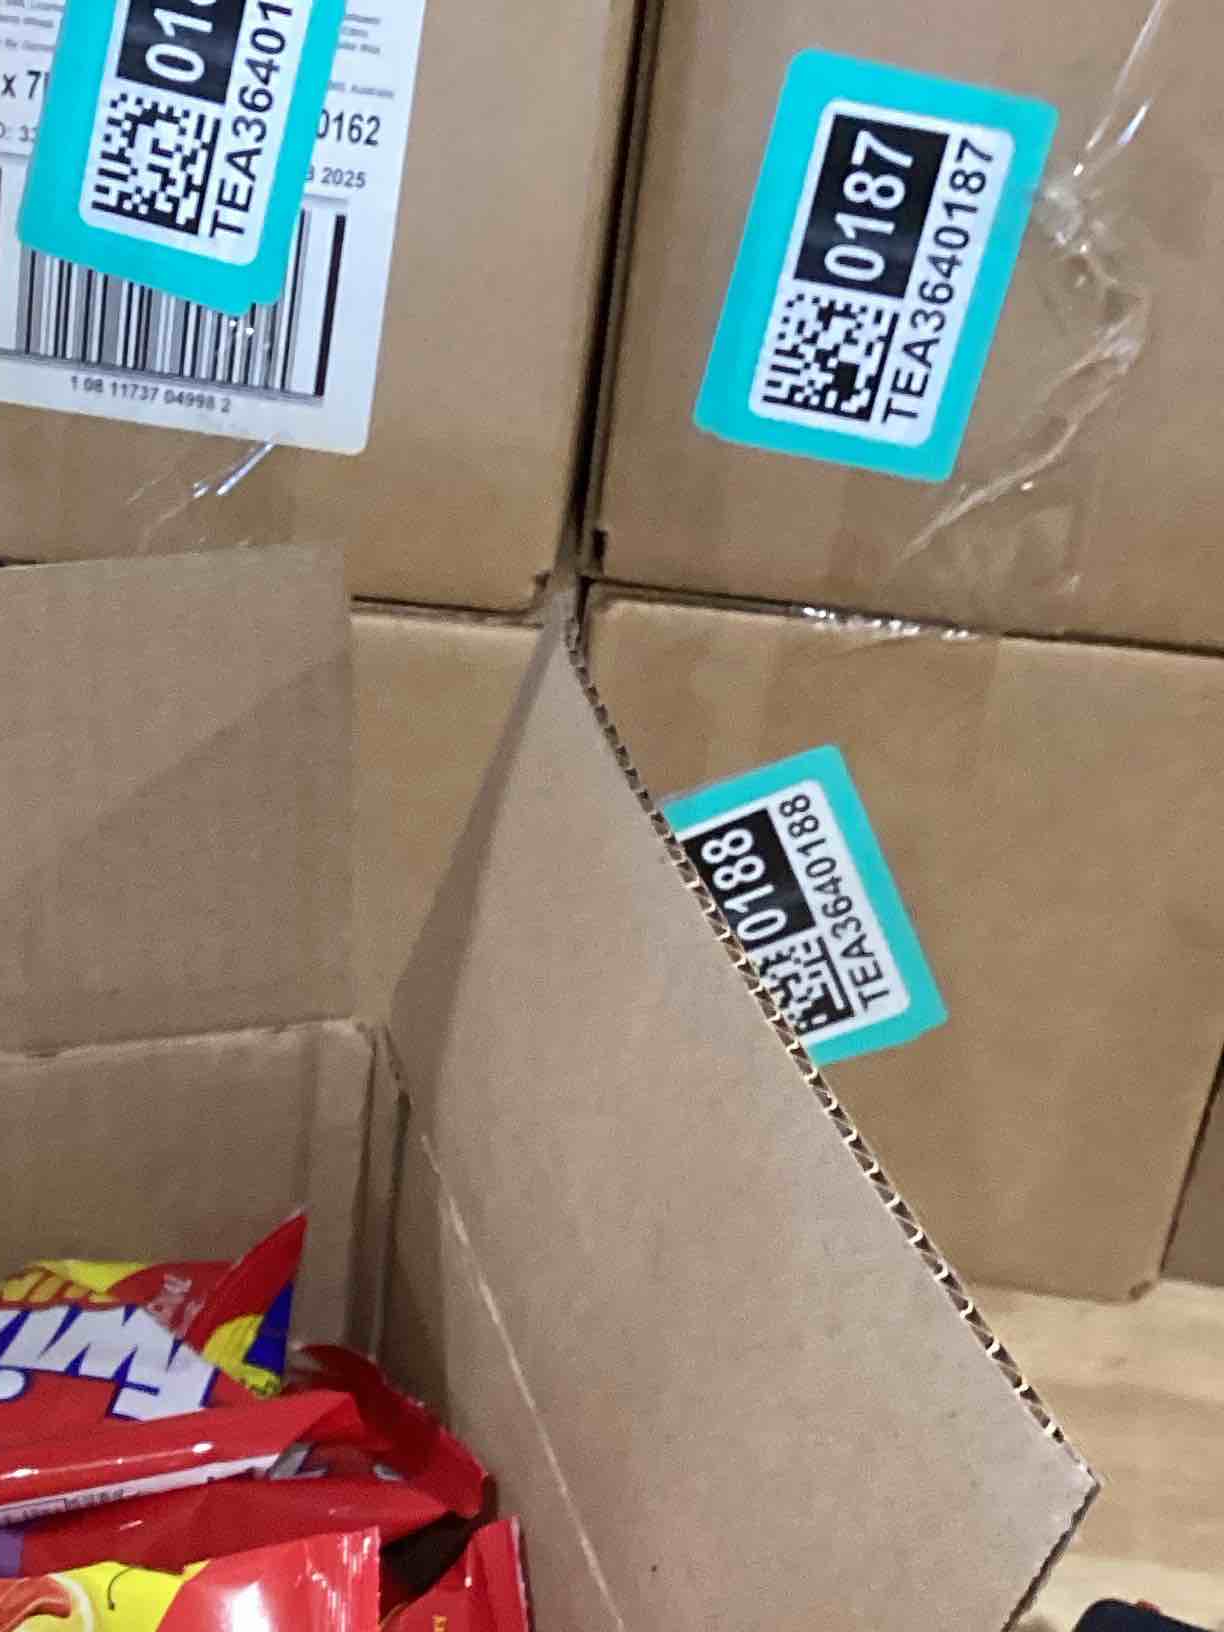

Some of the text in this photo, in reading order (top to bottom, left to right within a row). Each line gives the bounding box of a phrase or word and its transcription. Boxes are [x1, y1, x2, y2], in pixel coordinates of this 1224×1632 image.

[209, 0, 294, 238] TEA36401
[321, 166, 367, 188] 2025
[823, 129, 916, 283] 0187
[882, 137, 995, 424] TEA3640187
[701, 828, 788, 942] 0188
[779, 793, 890, 1013] TEA3640188
